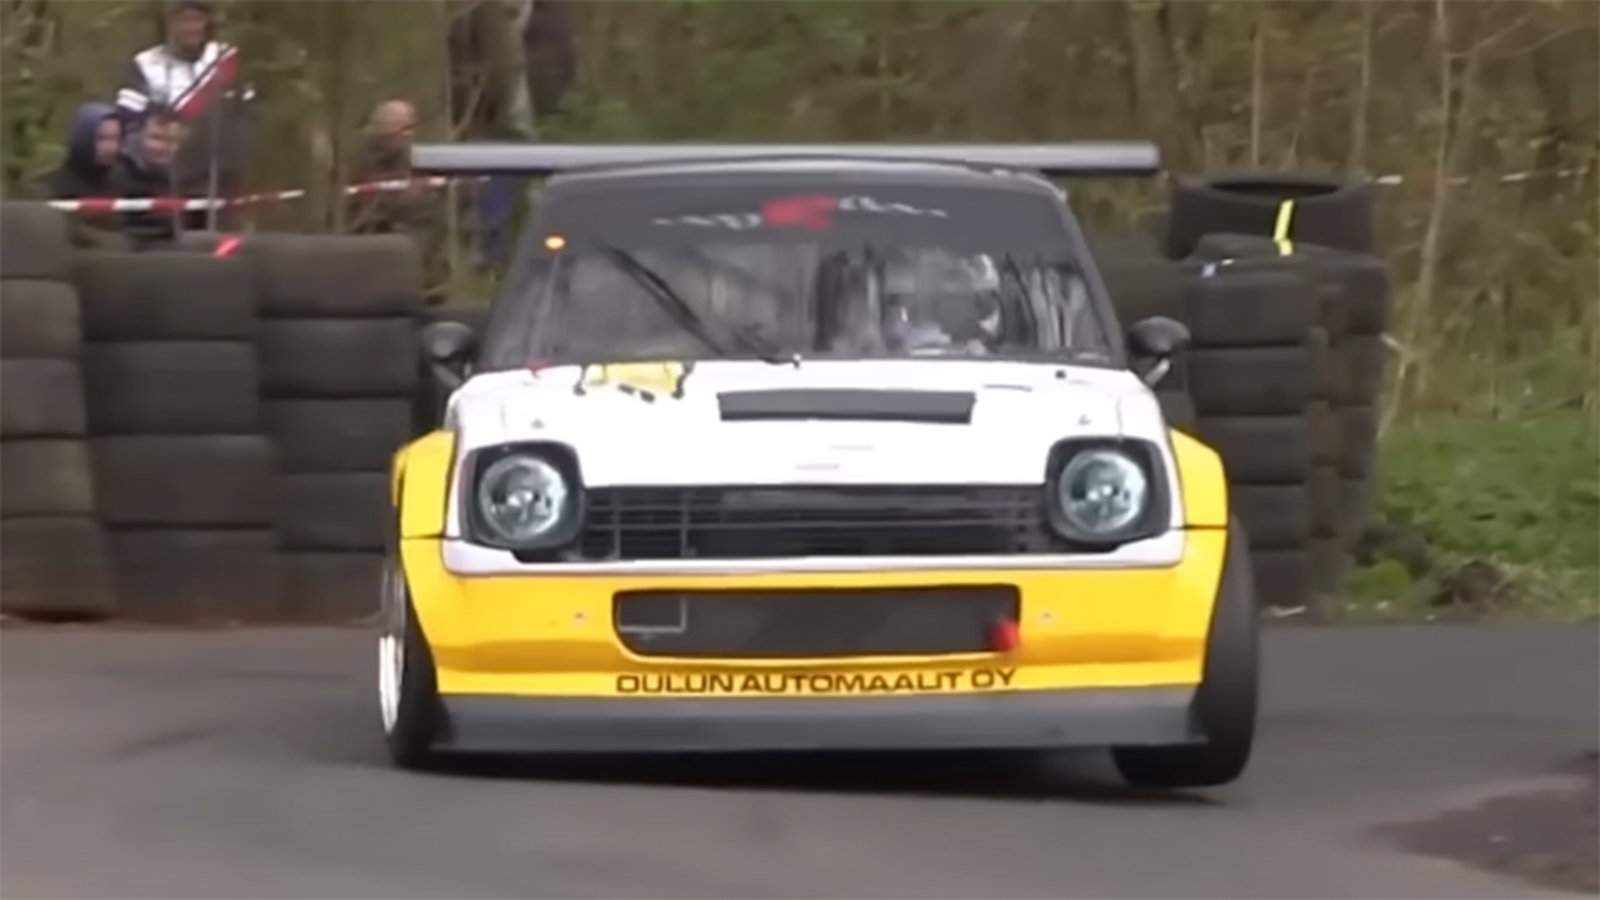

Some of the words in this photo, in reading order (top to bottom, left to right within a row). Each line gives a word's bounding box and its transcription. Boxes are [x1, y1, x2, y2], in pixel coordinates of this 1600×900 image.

[616, 674, 734, 692] OULUN
[740, 671, 963, 692] AUTOMAALIT
[971, 666, 1017, 689] OY
